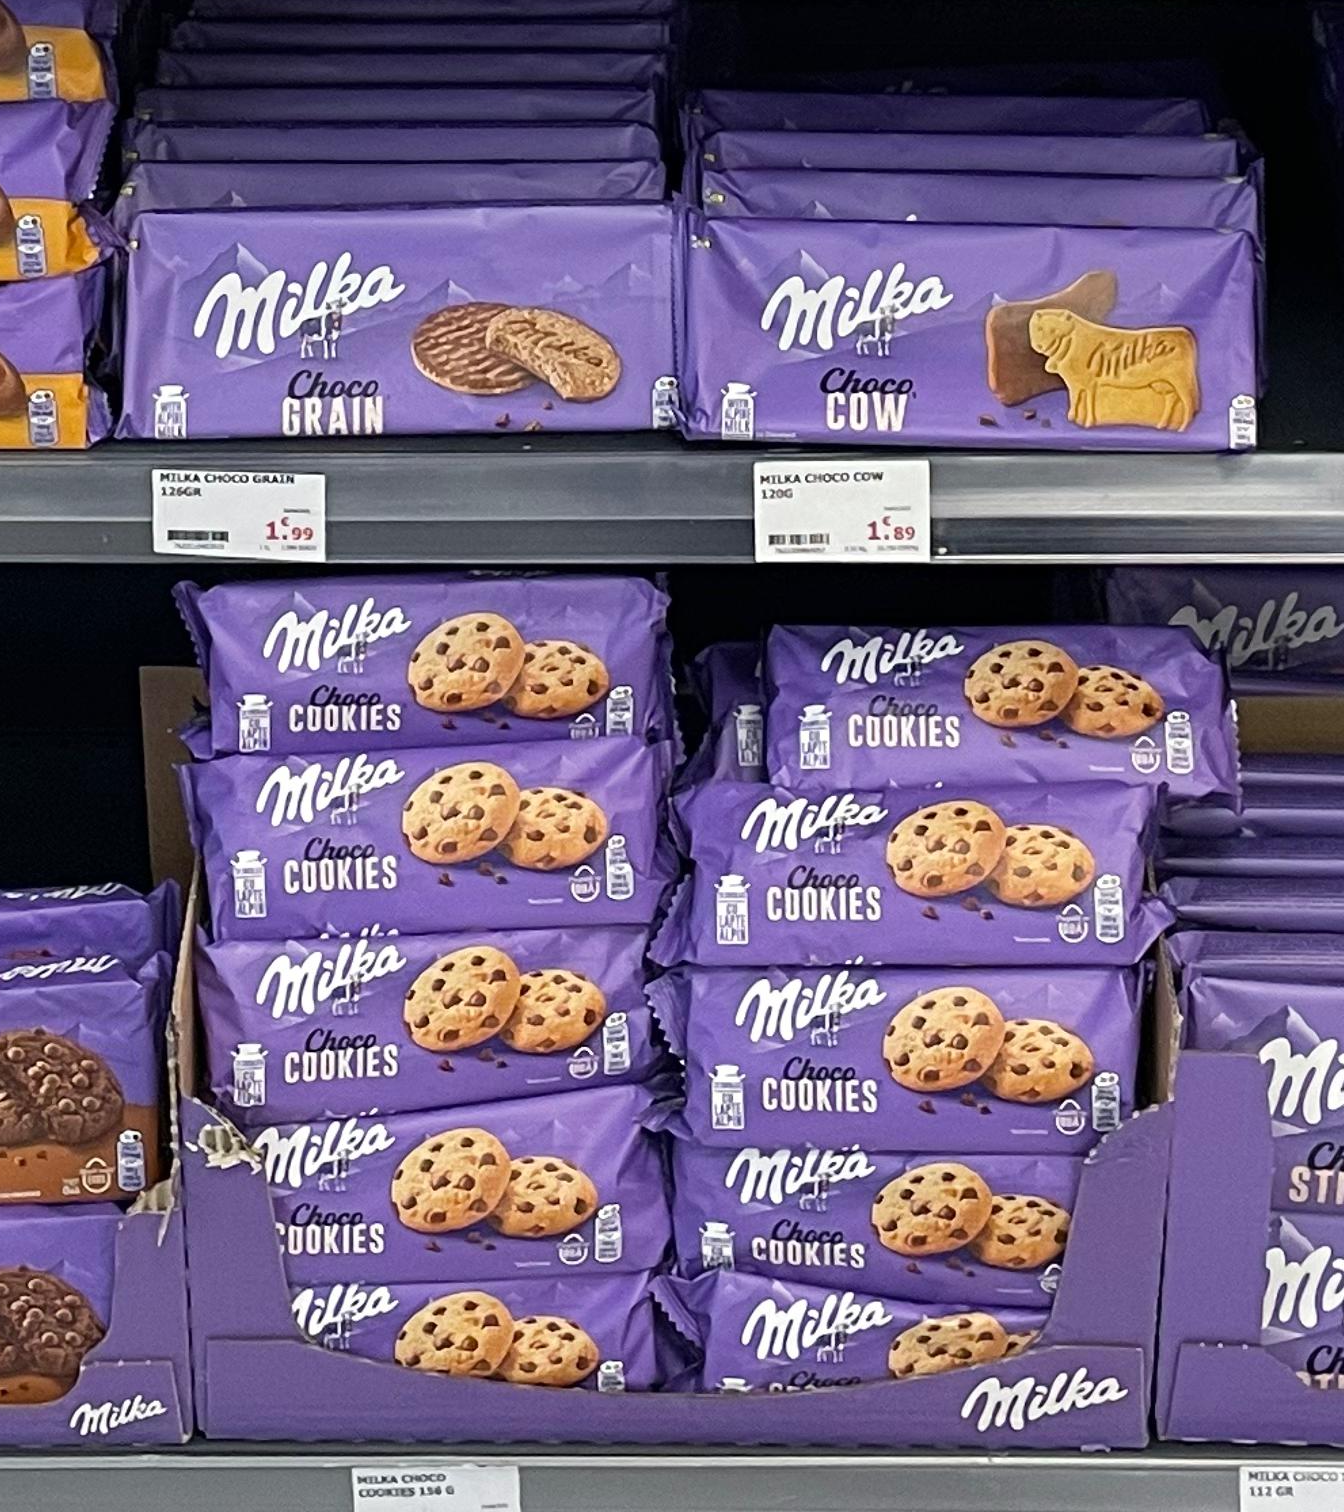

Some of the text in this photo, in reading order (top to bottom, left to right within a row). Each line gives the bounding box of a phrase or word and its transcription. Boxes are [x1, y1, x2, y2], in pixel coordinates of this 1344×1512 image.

[193, 251, 406, 359] Milka
[760, 262, 955, 352] Milka
[286, 369, 379, 401] Choco
[819, 366, 914, 396] Choco
[281, 395, 384, 437] GRAIN
[824, 392, 908, 433] COW
[160, 473, 295, 484] MILKA CHOCO GRAIN
[161, 486, 201, 497] 126GR
[760, 471, 884, 484] MILKA CHOCO COW
[761, 489, 793, 499] 120G
[263, 597, 412, 674] Milka
[821, 629, 965, 686] Milka
[288, 703, 401, 732] COOKIES
[848, 714, 961, 749] COOKIES
[255, 753, 405, 827] Milka
[741, 793, 889, 854] Milka
[304, 837, 375, 860] Choco
[283, 855, 397, 893] COOKIES
[766, 887, 882, 922] COOKIES
[255, 940, 407, 1020] Milka
[734, 970, 888, 1044] Milka
[283, 1043, 399, 1084] COOKIES
[761, 1078, 879, 1113] COOKIES
[741, 1291, 893, 1362] Milka
[70, 1395, 168, 1436] Milka
[960, 1367, 1130, 1433] Milka
[357, 1474, 446, 1484] MILKA CHOCO
[359, 1488, 415, 1498] COOKIES
